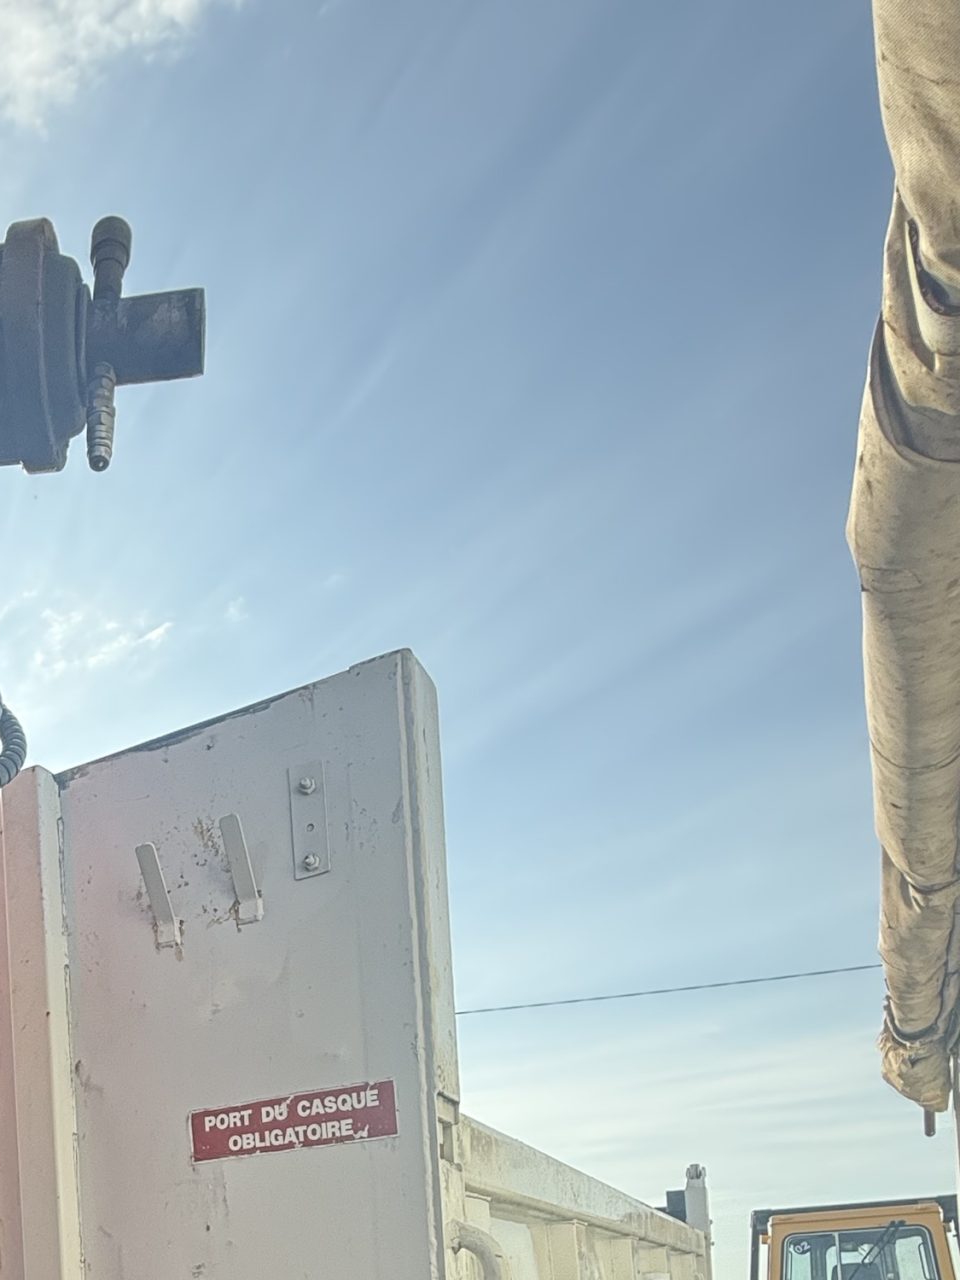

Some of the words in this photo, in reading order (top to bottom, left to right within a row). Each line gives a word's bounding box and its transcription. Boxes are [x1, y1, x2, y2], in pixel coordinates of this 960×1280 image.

[204, 1110, 252, 1132] PORT
[261, 1103, 289, 1123] DU
[297, 1089, 380, 1118] CASQUE
[228, 1119, 354, 1152] OBLIGATOIRE
